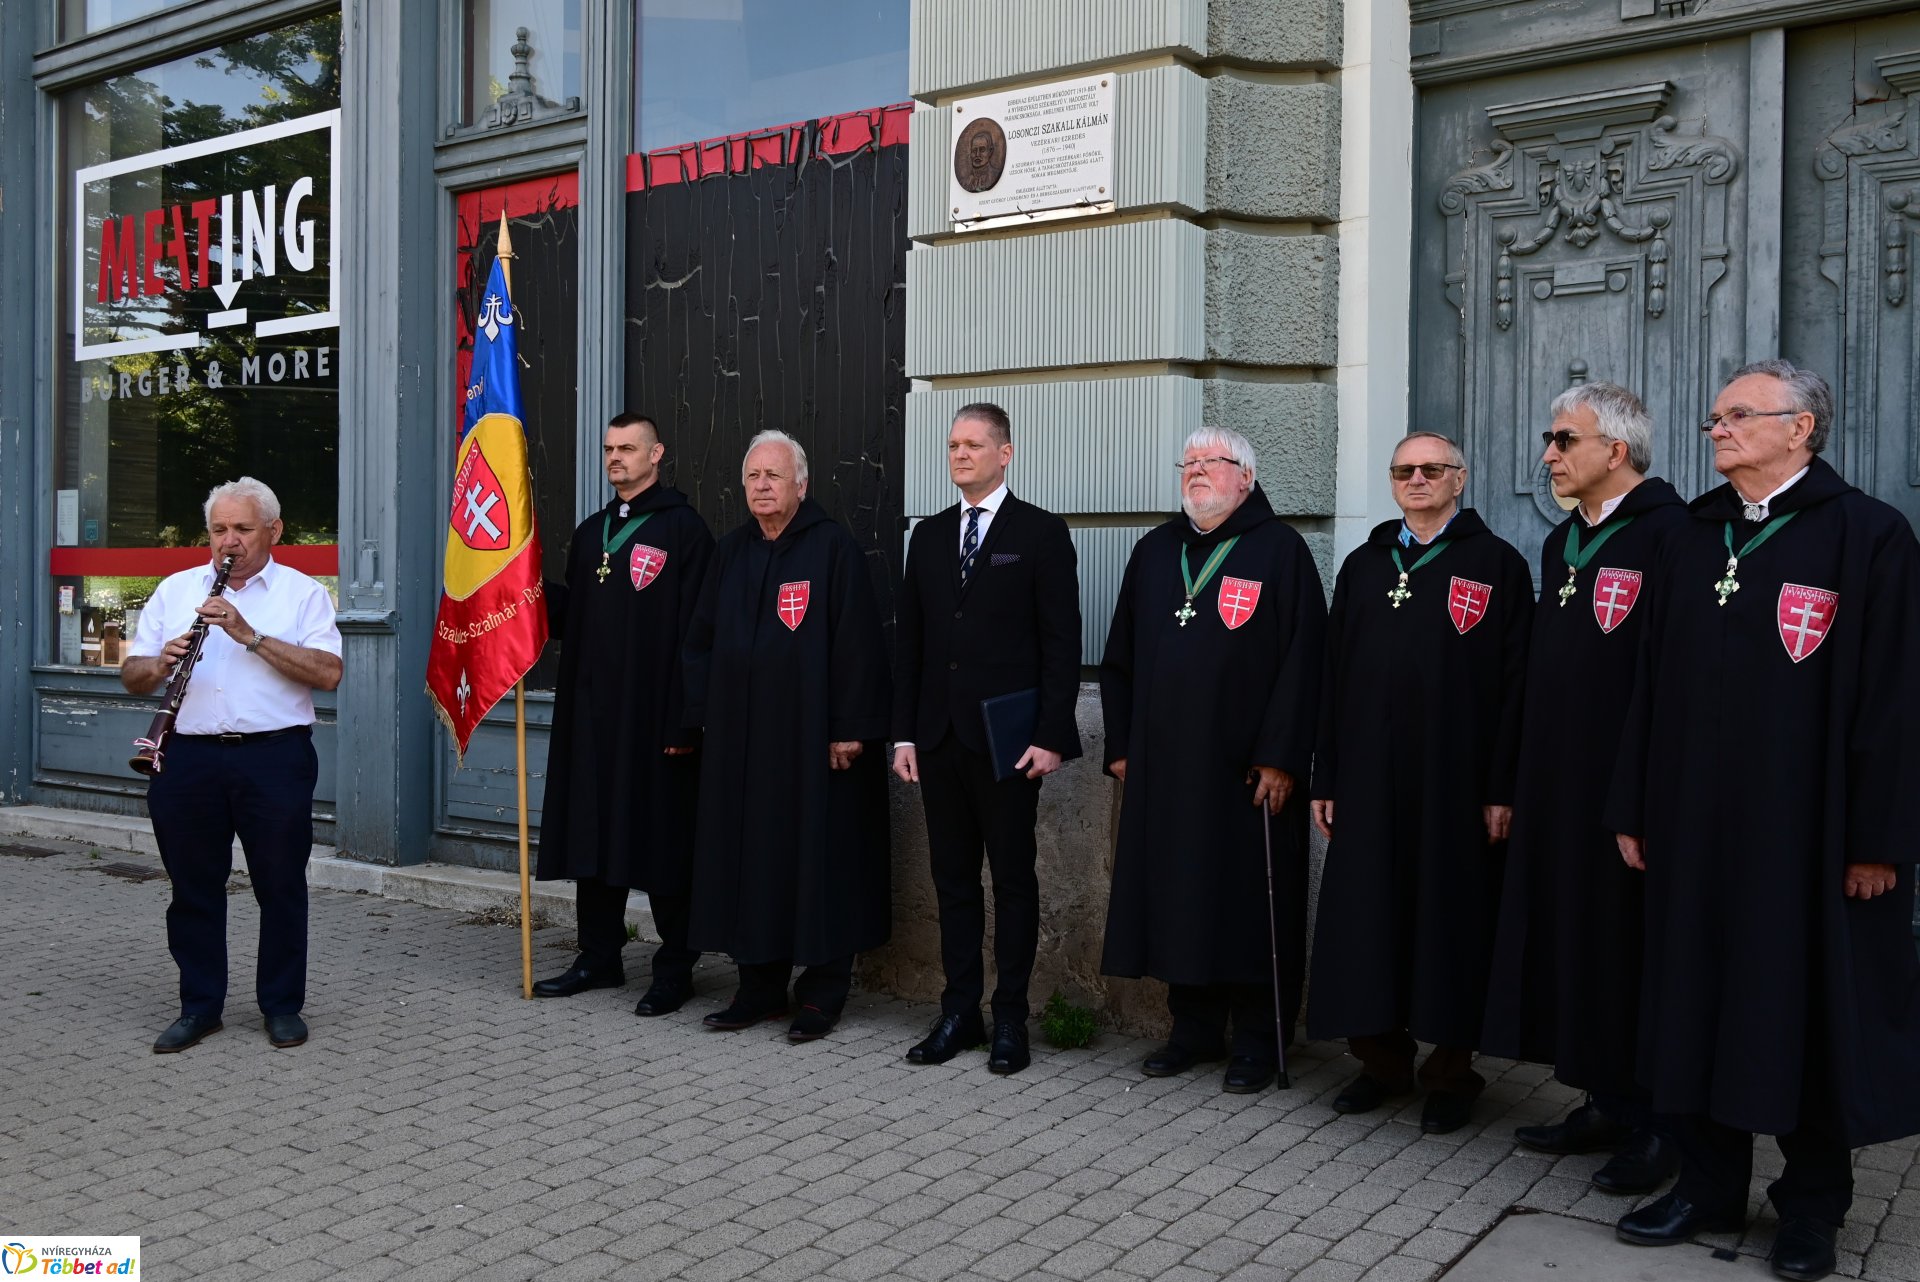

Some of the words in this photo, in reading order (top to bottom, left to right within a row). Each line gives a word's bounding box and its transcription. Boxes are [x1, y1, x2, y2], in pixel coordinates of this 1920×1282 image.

[1008, 126, 1040, 140] LOSONCZI
[1041, 120, 1075, 135] SZAKALL
[1076, 112, 1109, 129] KÁLMÁN
[97, 176, 315, 310] MEATING
[81, 364, 191, 404] BURGER
[207, 361, 224, 390] &
[242, 346, 330, 386] MORE
